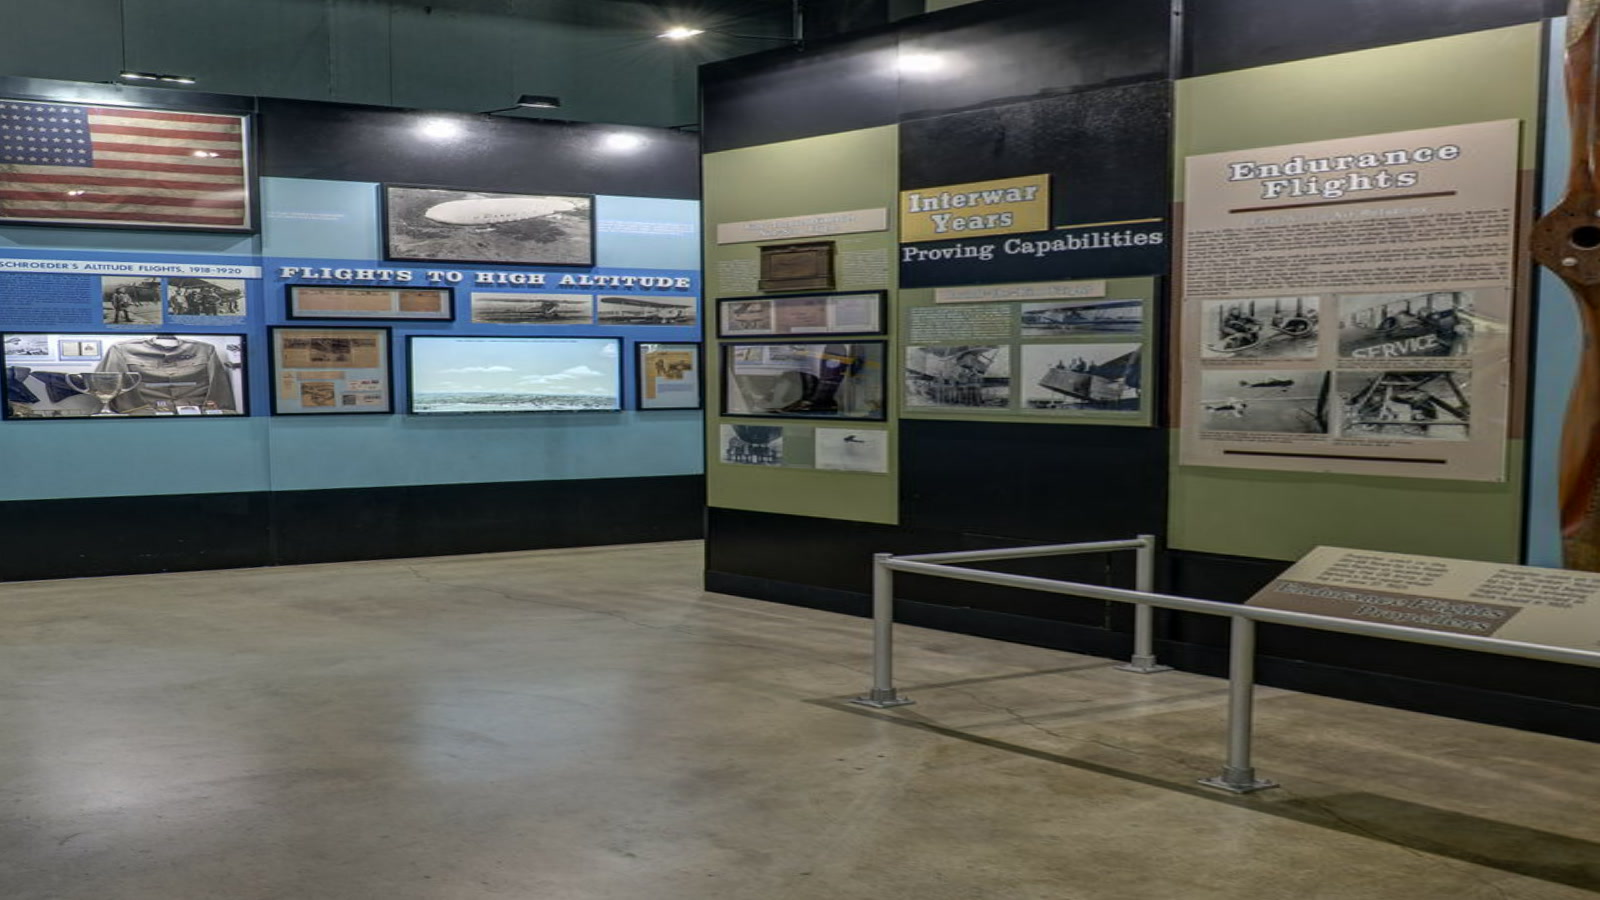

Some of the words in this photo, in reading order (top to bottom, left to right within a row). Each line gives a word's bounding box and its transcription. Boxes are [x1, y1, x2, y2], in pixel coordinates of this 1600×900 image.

[1229, 145, 1460, 182] Endurance
[1261, 171, 1418, 199] Flights
[908, 185, 1038, 213] Interwar
[931, 212, 1014, 234] Years
[902, 243, 996, 262] Proving
[1003, 230, 1164, 257] Capabilities
[84, 263, 133, 272] ALTITUDE
[279, 265, 413, 282] FLIGHTS
[427, 269, 464, 283] TO
[475, 271, 546, 285] HIGH
[558, 273, 691, 289] ALTITUDE
[1352, 333, 1439, 357] SERVICE
